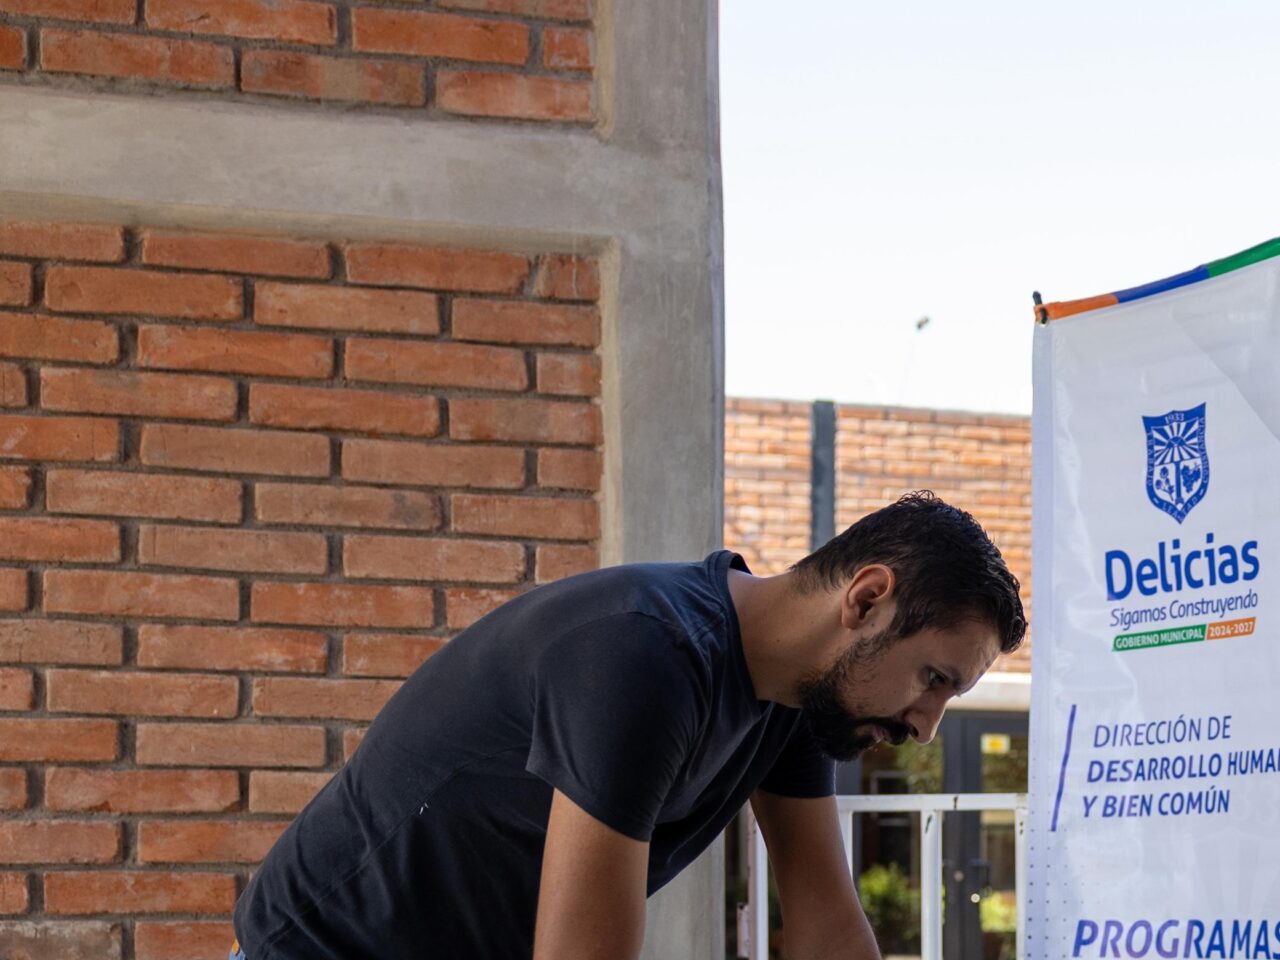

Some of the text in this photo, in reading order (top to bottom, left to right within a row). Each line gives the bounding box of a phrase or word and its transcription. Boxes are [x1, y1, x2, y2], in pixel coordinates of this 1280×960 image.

[1164, 412, 1185, 425] 1933
[1105, 533, 1260, 601] Delicias
[1110, 588, 1259, 631] Sigamos Construyendo
[1115, 621, 1254, 649] GOBIERNO MUNICIPAL 2024-2027
[1093, 714, 1232, 748] DIRECCIÓN DE
[1086, 753, 1222, 783] DESARROLLO
[1082, 795, 1099, 818] Y
[1101, 794, 1152, 818] BIEN
[1158, 785, 1230, 815] COMÚN
